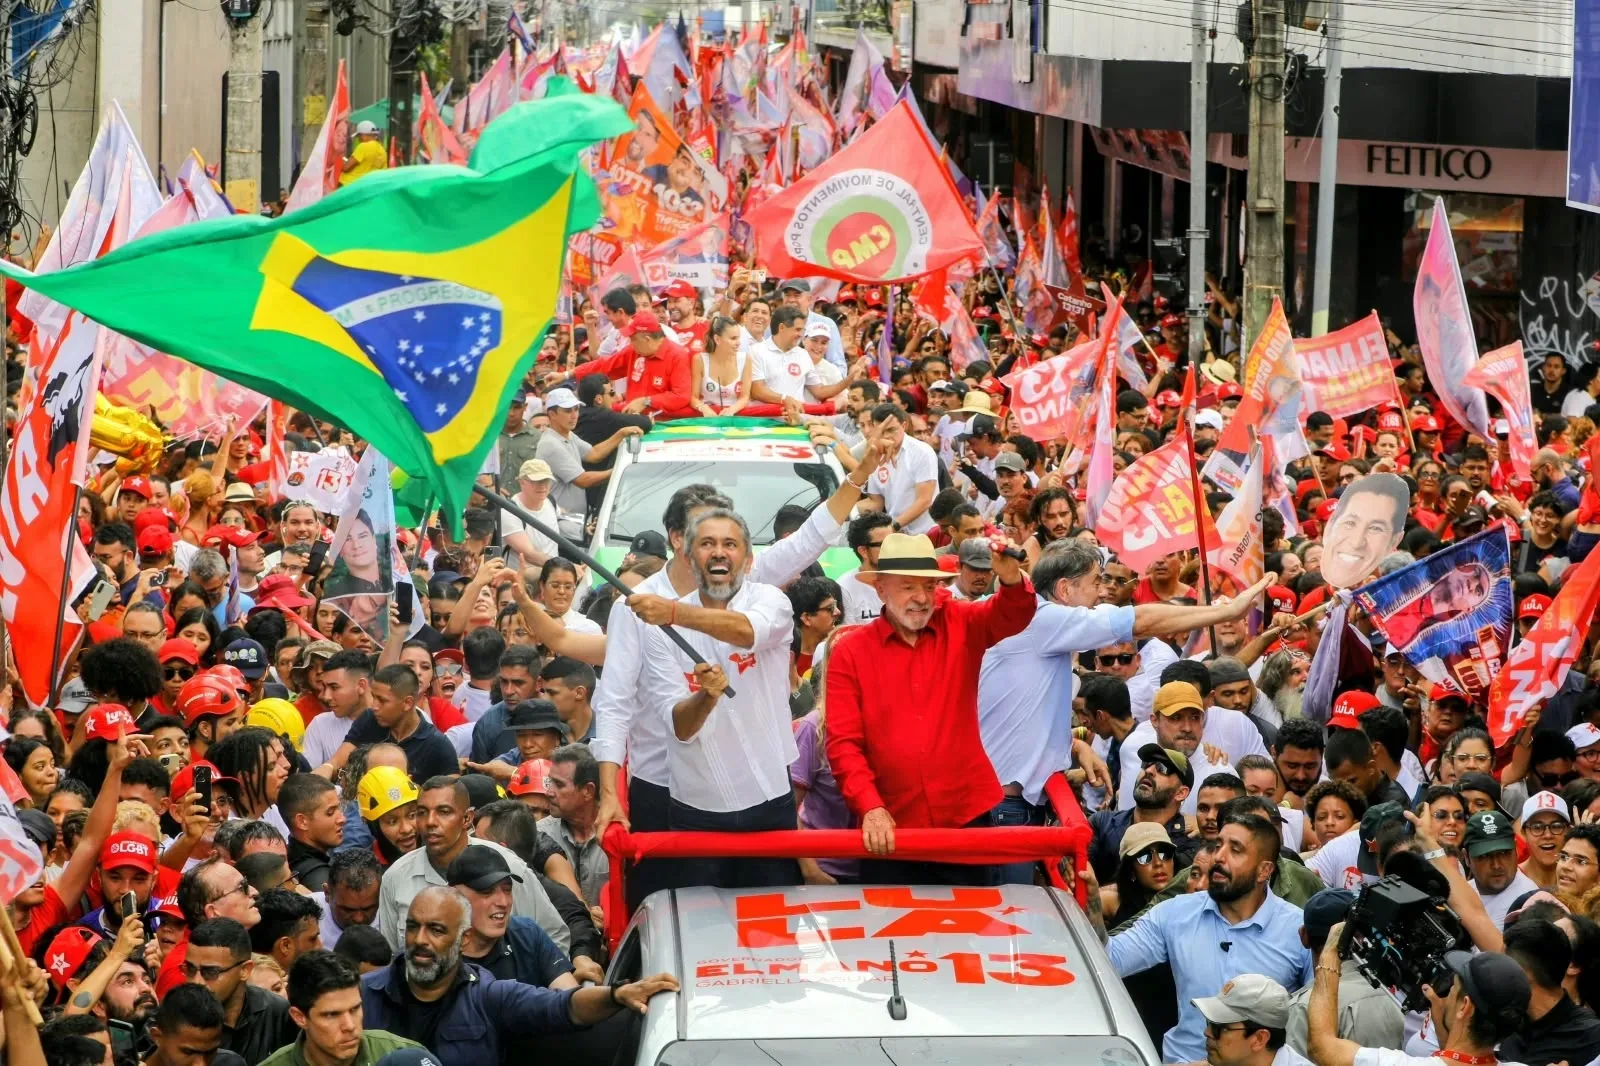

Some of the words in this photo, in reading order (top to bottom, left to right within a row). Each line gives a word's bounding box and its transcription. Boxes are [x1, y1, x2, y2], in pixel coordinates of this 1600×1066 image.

[1366, 144, 1492, 181] FEITIÇO
[1057, 292, 1093, 309] Catanho
[316, 468, 341, 493] 13
[1523, 602, 1543, 611] LULA
[1334, 704, 1355, 716] LULA
[1536, 793, 1556, 808] 13
[119, 843, 149, 856] LGBT
[695, 959, 938, 978] ELMANO
[938, 951, 1076, 987] 13
[695, 975, 812, 988] GABRIELLA
